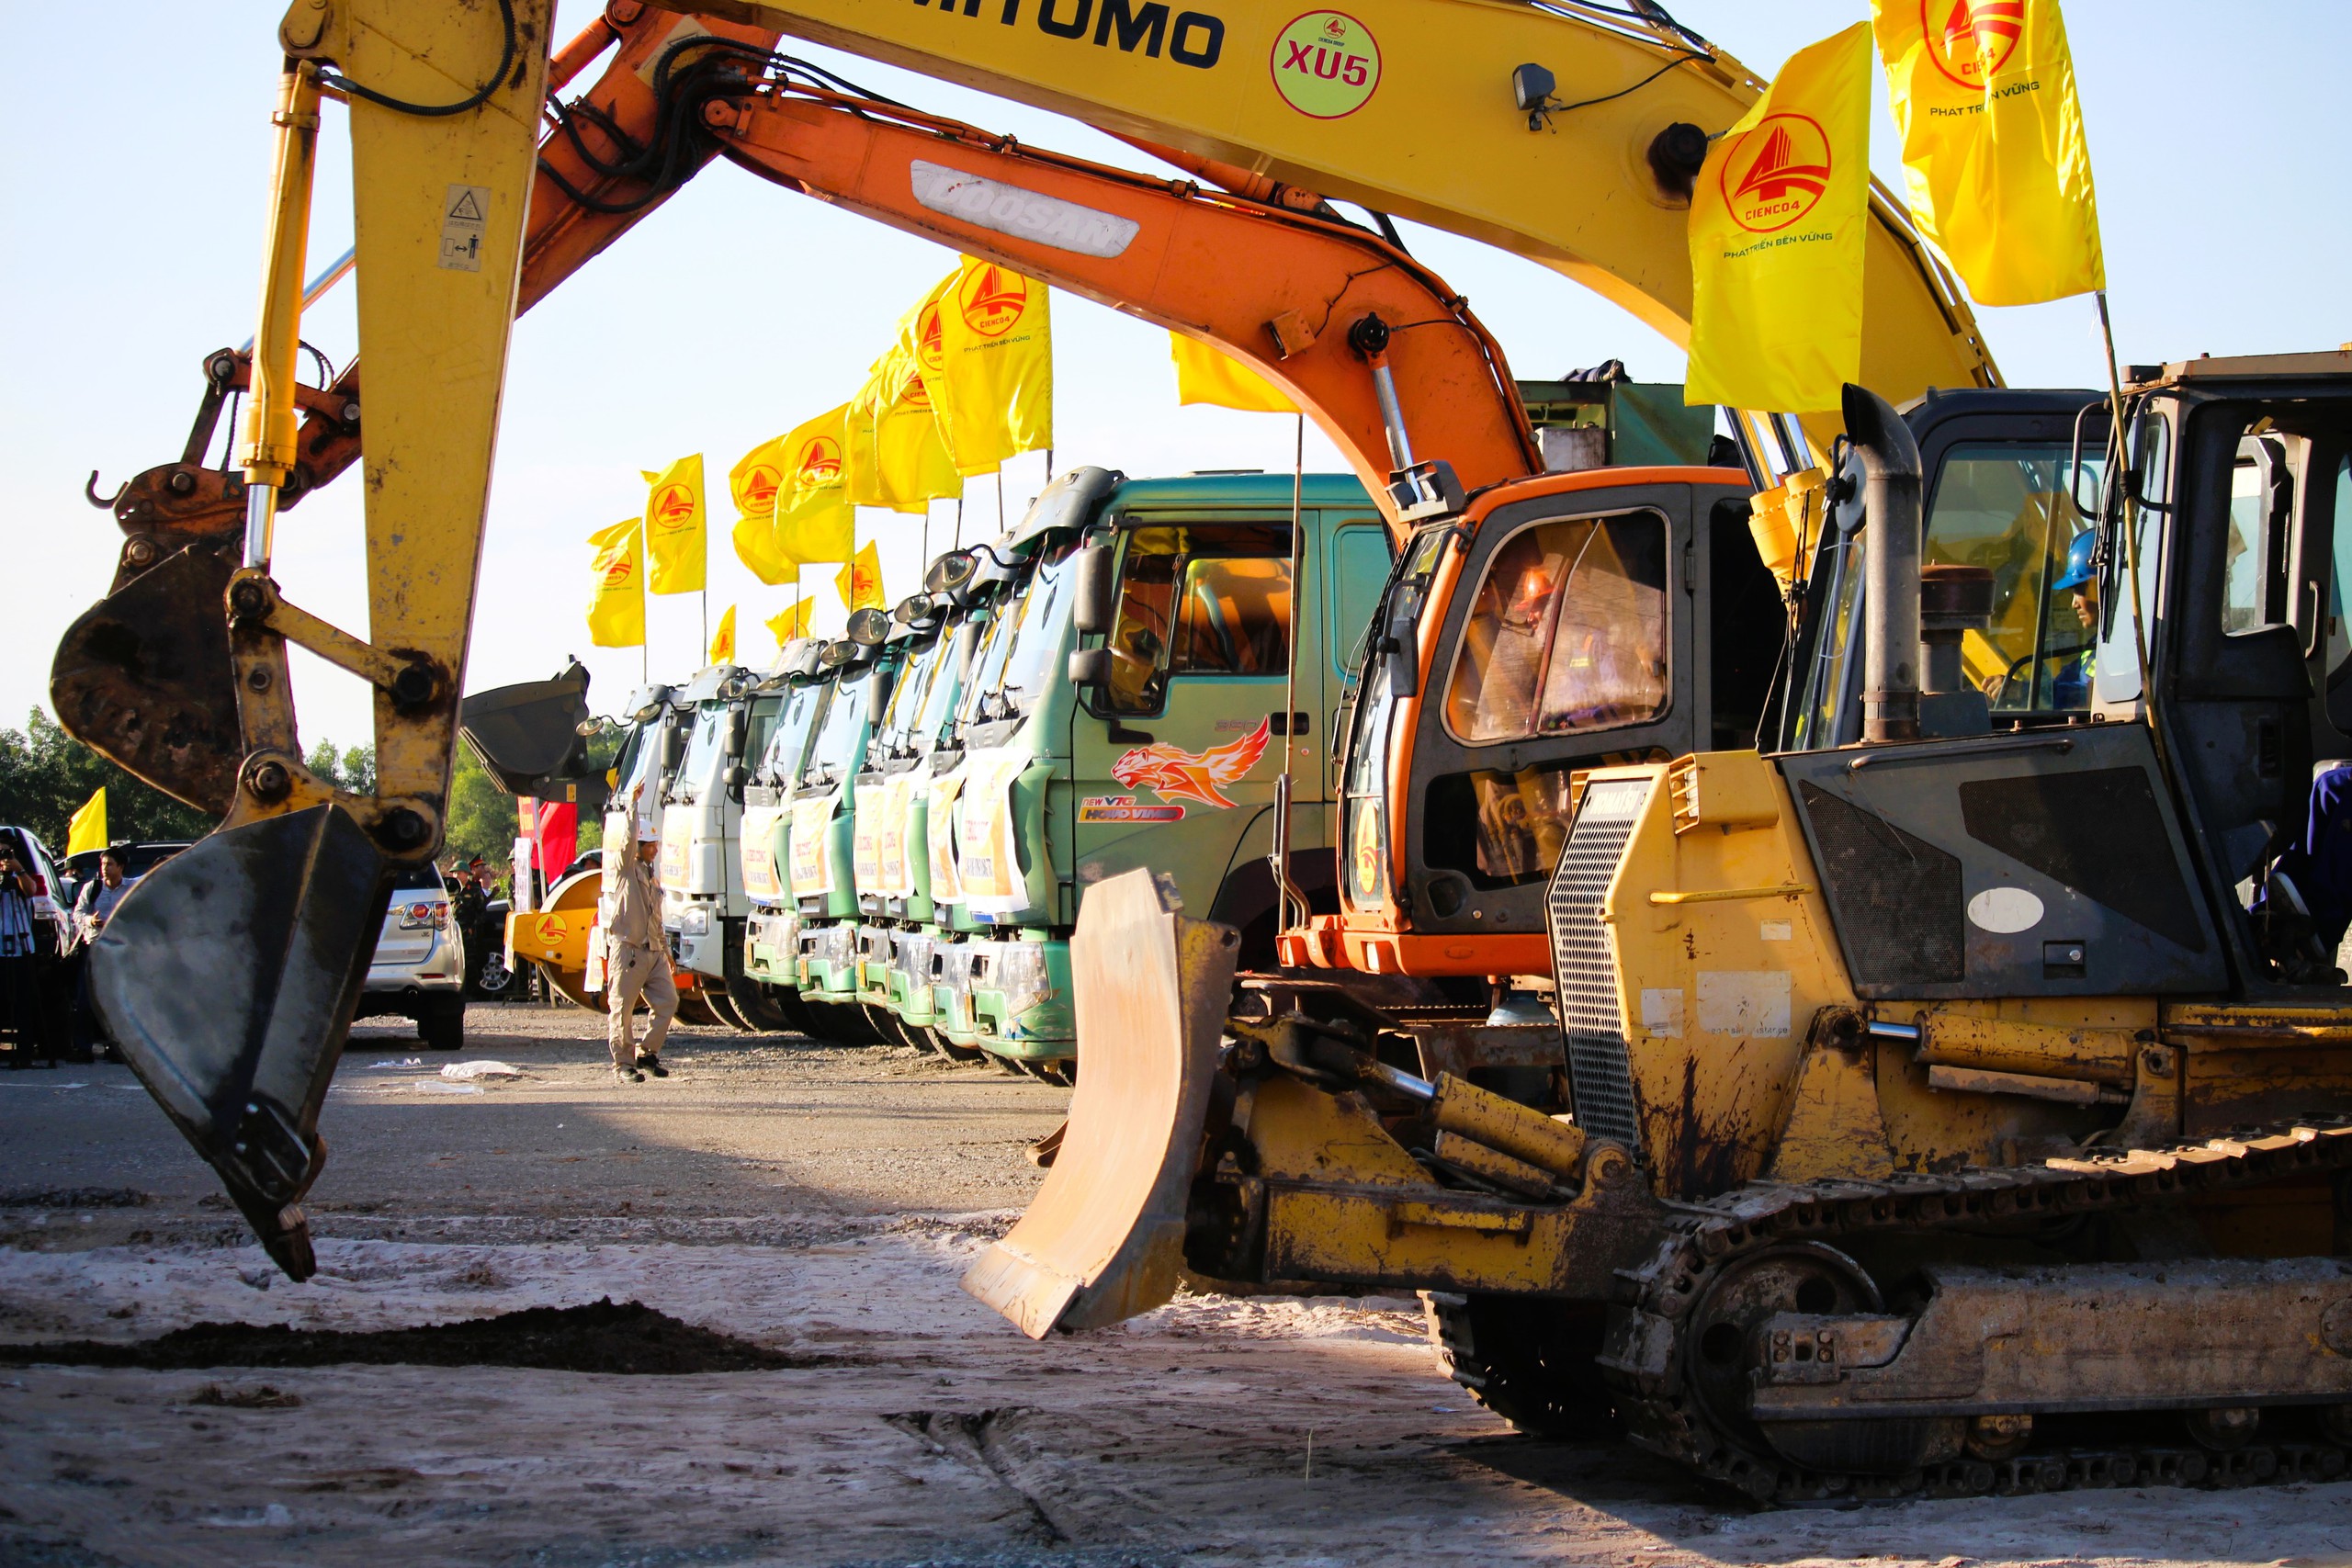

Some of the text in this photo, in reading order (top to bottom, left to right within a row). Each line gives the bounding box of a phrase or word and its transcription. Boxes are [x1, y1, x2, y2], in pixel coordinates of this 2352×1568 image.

[1282, 39, 1369, 86] XU5
[925, 175, 1117, 249] DOOSAN
[1745, 200, 1801, 221] CIENCO4
[1799, 231, 1833, 243] VỮNG
